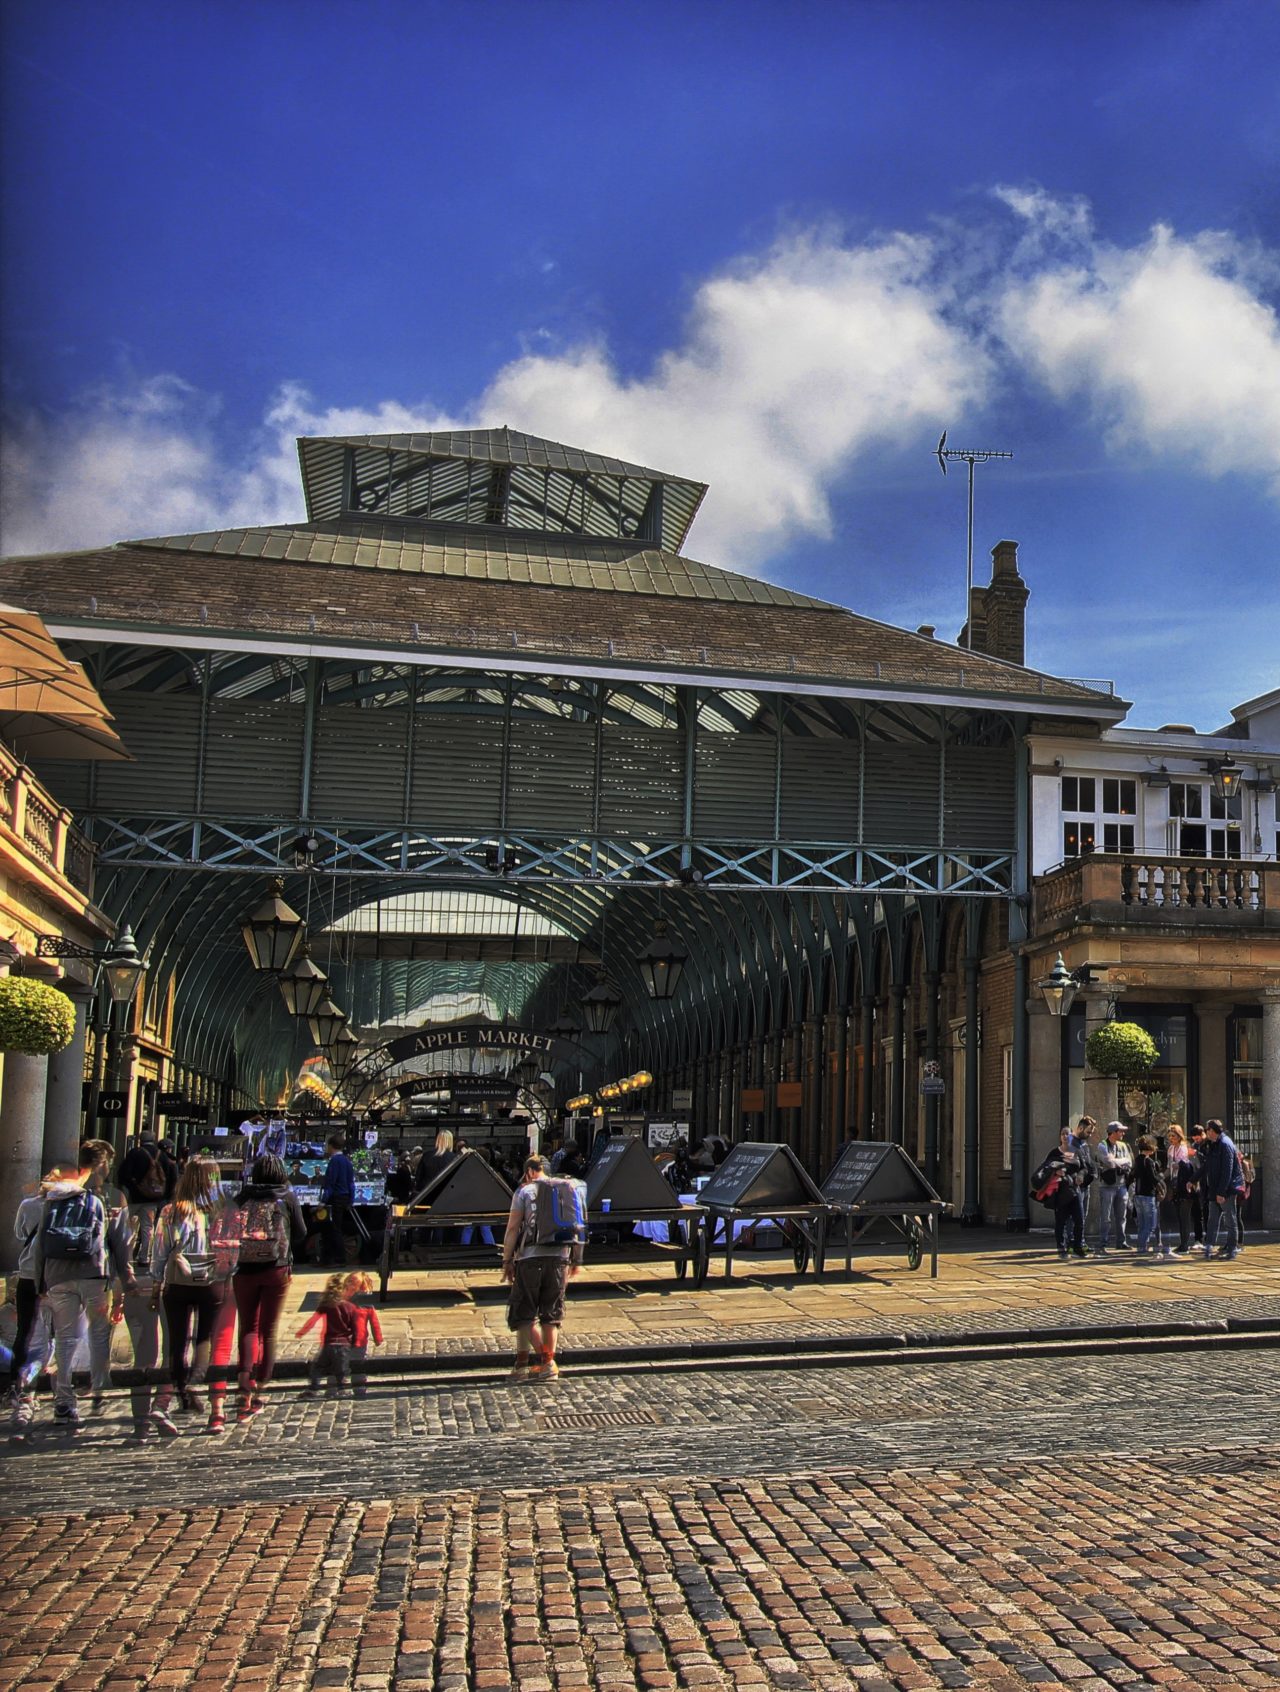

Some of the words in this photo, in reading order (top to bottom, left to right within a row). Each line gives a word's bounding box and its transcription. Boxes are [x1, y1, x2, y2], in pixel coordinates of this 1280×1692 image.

[414, 1030, 468, 1052] APPLE
[478, 1030, 556, 1051] MARKET
[412, 1079, 448, 1093] APPLE
